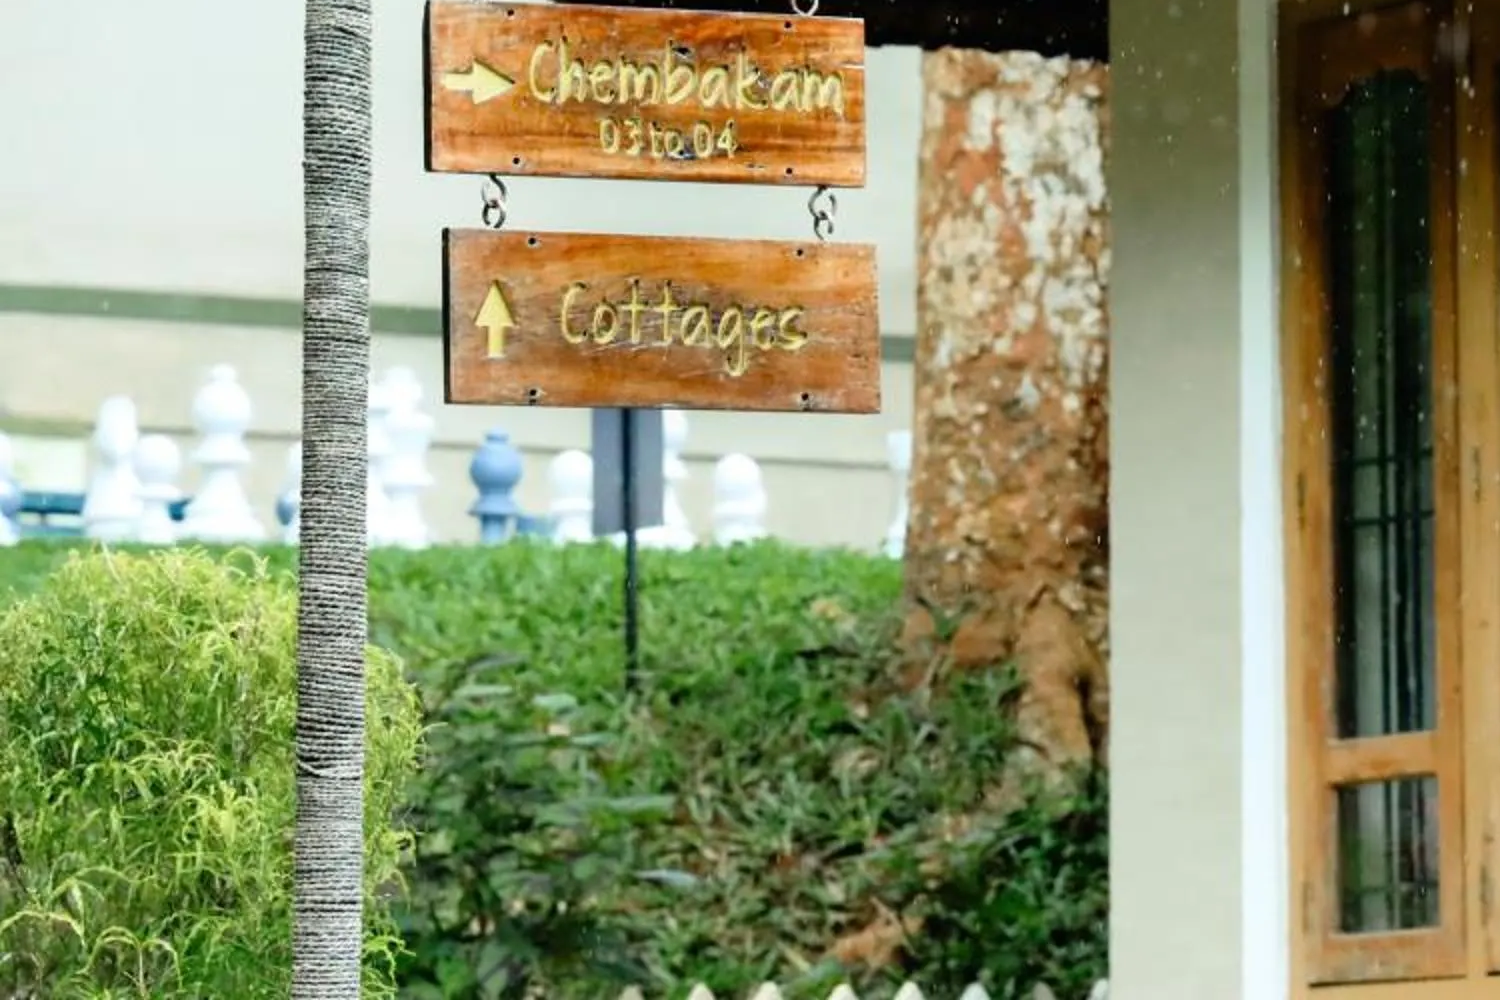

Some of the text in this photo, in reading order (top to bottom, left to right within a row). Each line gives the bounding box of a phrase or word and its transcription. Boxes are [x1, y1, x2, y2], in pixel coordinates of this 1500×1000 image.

[528, 34, 845, 118] Chembakam
[600, 115, 739, 159] 03 to 04
[561, 278, 809, 377] Cottages
